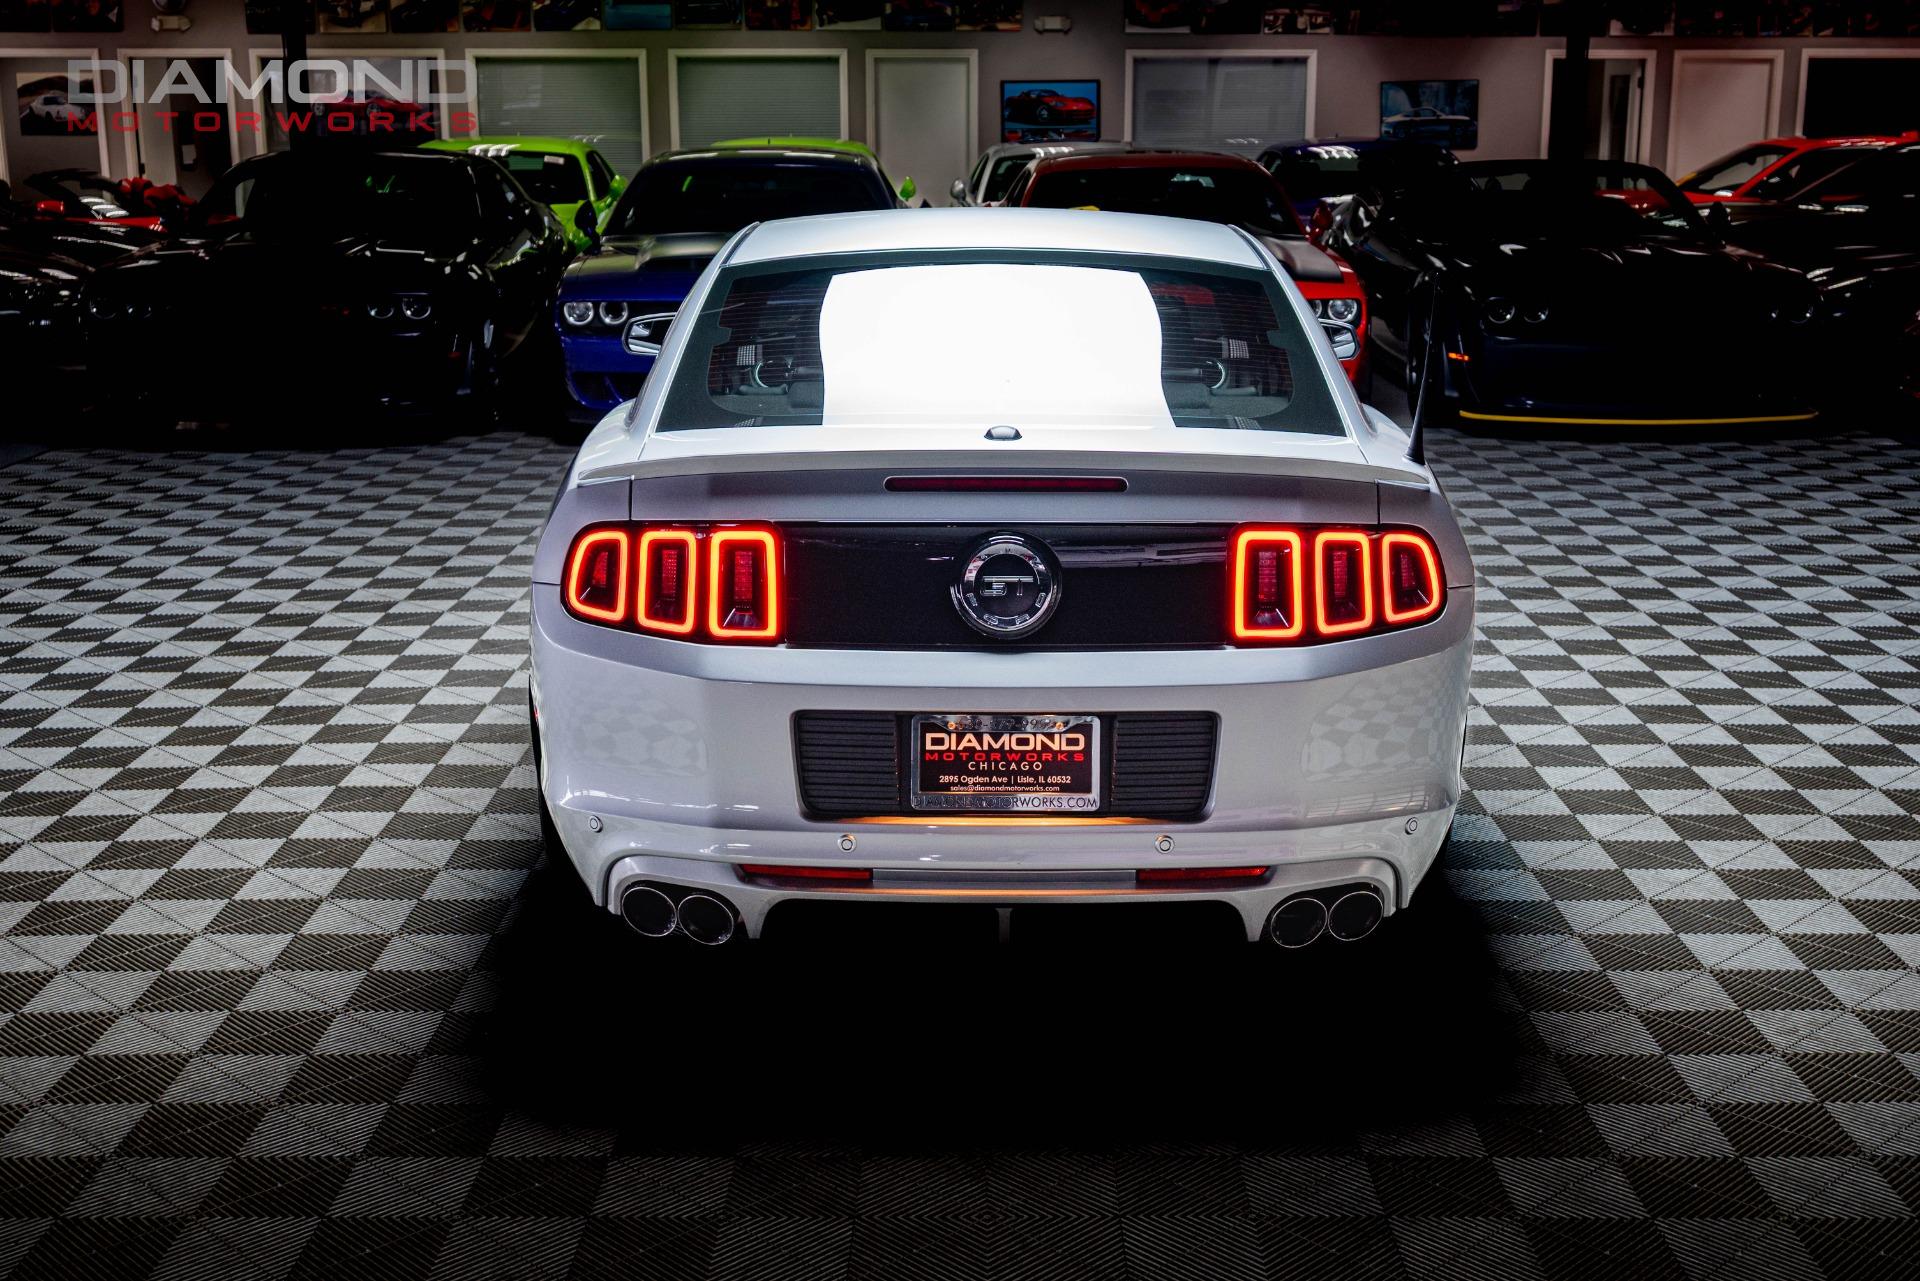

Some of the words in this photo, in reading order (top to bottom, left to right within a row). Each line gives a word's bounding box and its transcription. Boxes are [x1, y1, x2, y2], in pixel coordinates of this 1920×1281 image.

[925, 733, 1085, 751] DIAMOND
[924, 753, 1085, 761] MOTORWORKS
[968, 761, 1042, 771] CHICAGO
[939, 775, 959, 783] 2895
[960, 775, 990, 785] Ogden
[991, 775, 1008, 783] Ave
[1017, 775, 1037, 784] Lisle,
[1038, 775, 1046, 783] IL
[1047, 775, 1071, 783] 60532
